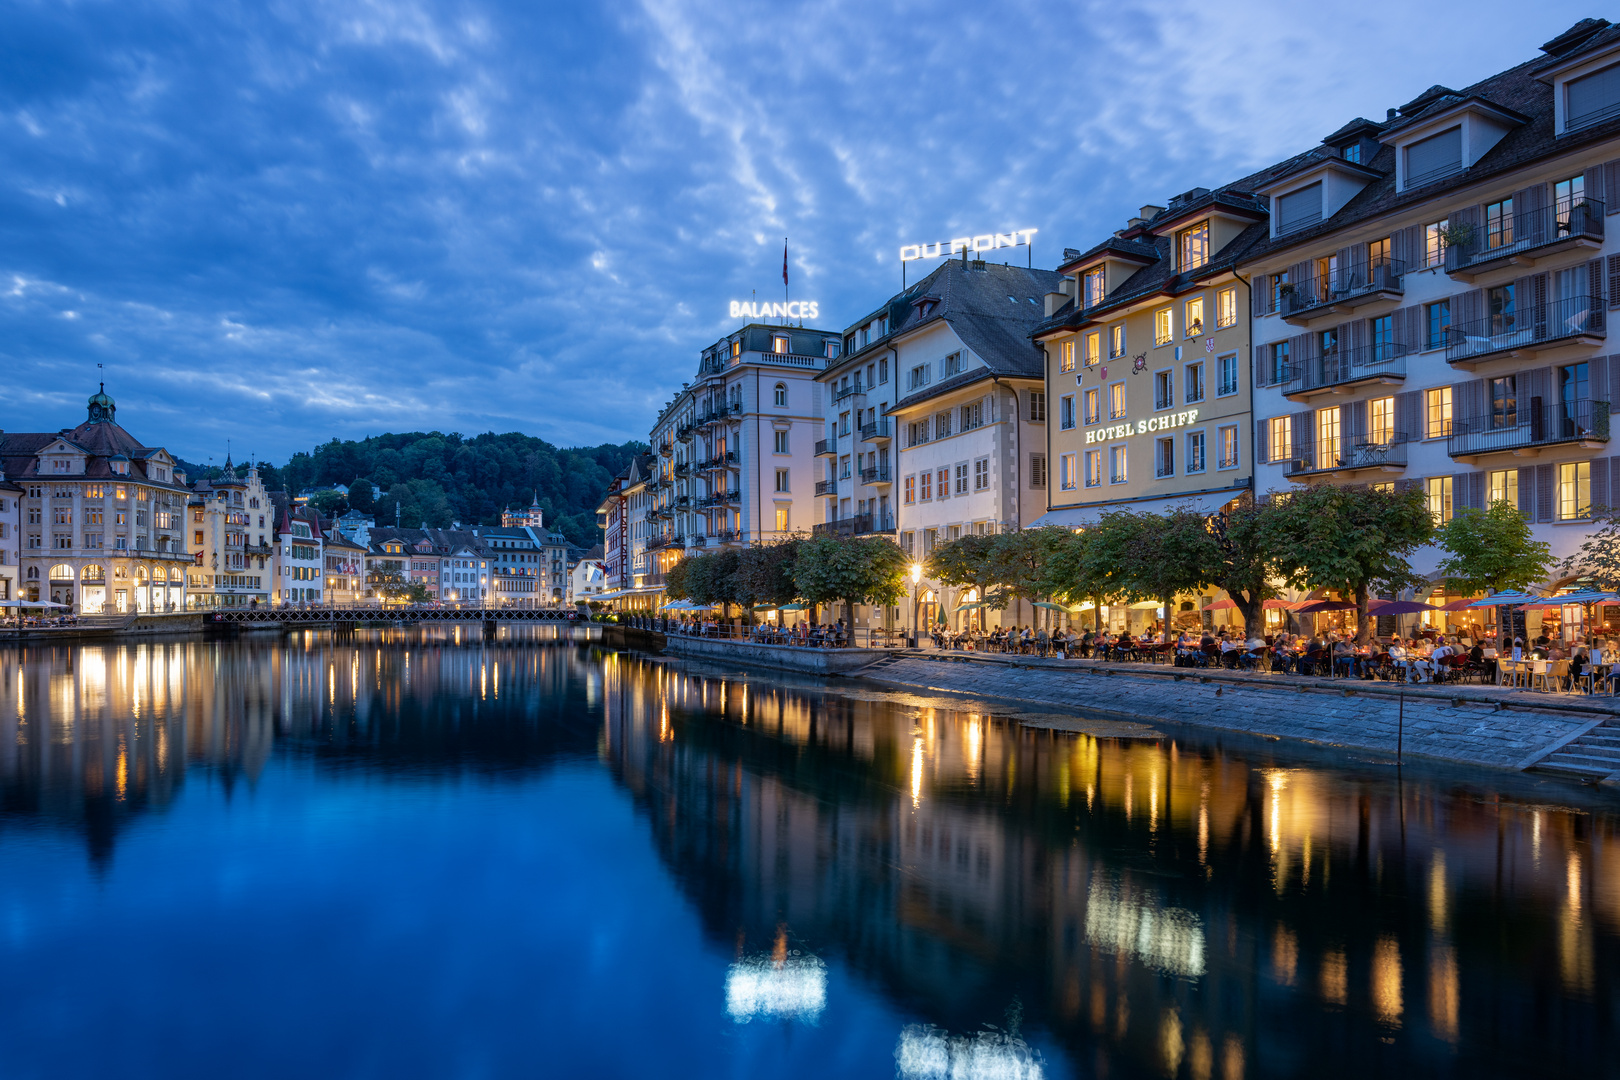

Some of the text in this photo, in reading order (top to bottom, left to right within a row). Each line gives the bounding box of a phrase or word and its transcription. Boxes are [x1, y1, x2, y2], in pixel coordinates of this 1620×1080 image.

[900, 228, 1038, 261] DU PONT
[730, 301, 819, 318] BALANCES
[1085, 409, 1198, 444] HOTEL SCHIFF
